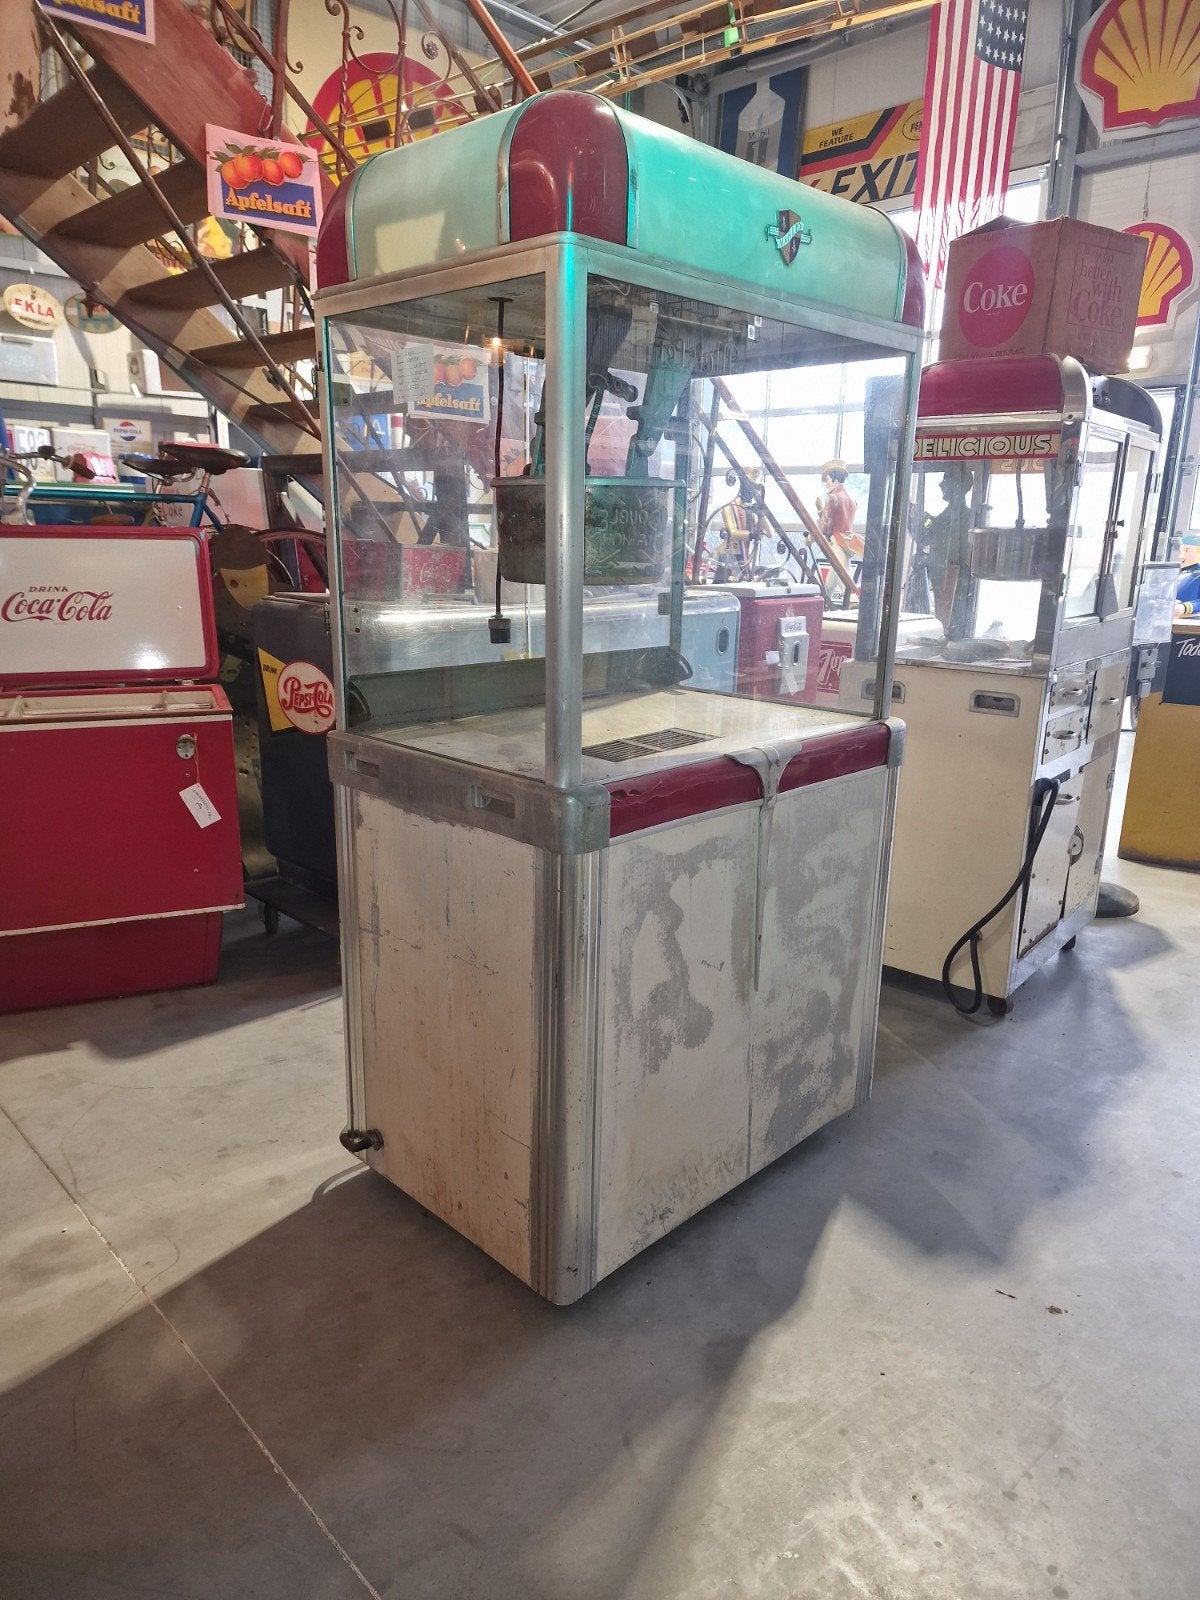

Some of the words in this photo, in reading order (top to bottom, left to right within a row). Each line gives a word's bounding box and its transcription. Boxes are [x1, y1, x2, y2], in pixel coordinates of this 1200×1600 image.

[819, 132, 854, 149] FEATURE
[831, 126, 844, 137] WE
[225, 187, 312, 219] Apfelsaft
[1080, 258, 1111, 282] better
[963, 281, 1028, 314] Coke
[1092, 276, 1122, 303] with
[14, 297, 56, 319] EKLA
[1073, 288, 1122, 326] Coke
[1, 591, 115, 622] Coca-Cola
[262, 663, 278, 675] DRINK
